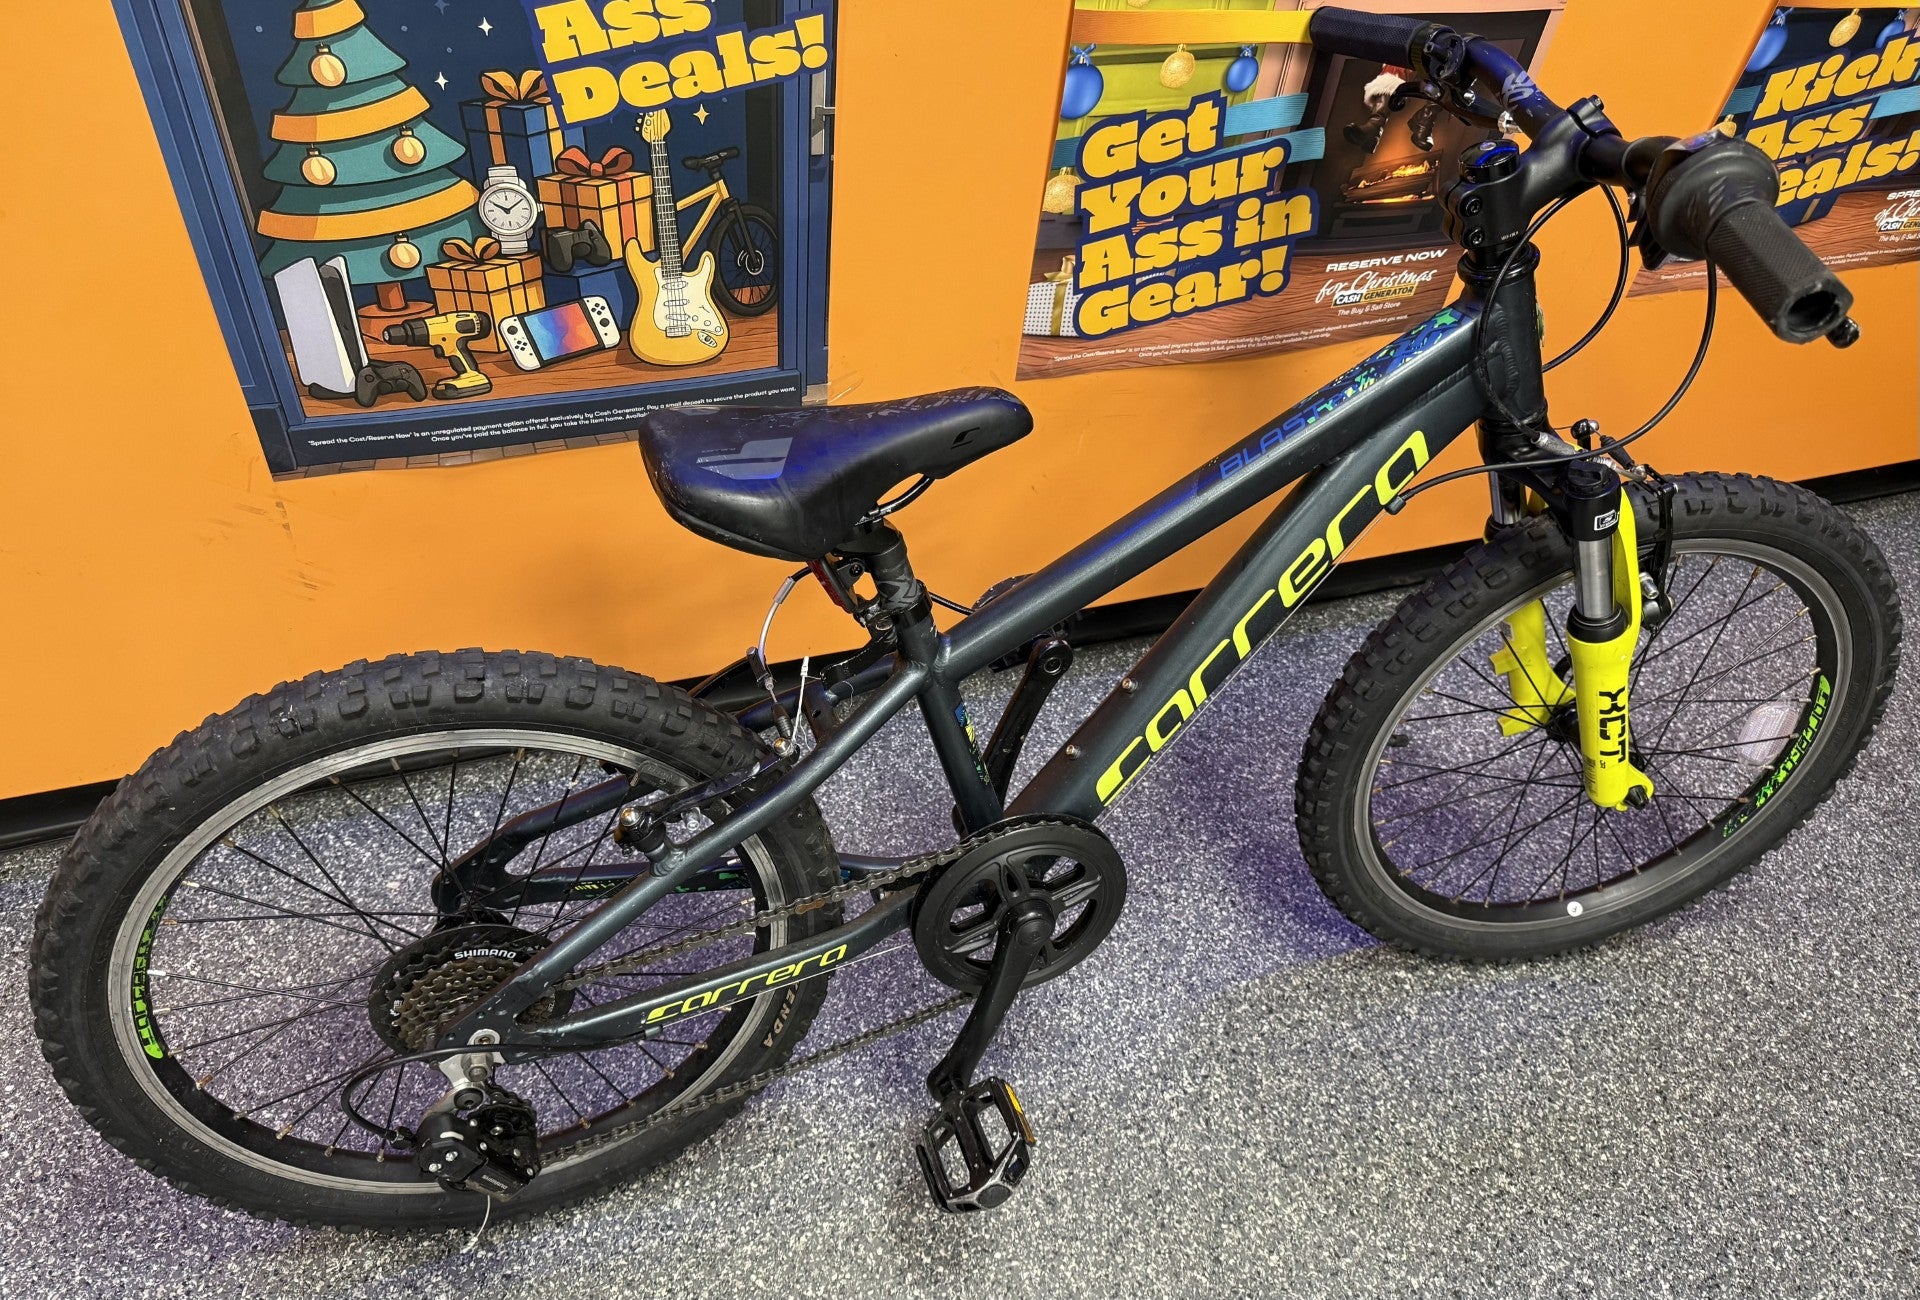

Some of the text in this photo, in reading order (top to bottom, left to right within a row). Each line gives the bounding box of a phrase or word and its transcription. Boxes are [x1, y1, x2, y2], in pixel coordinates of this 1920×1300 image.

[535, 0, 712, 63] Ass
[552, 14, 828, 124] Deals!
[1753, 36, 1920, 120] Kick
[1082, 100, 1219, 178] Get
[1745, 103, 1872, 160] Ass
[1081, 146, 1284, 233] Your
[1775, 129, 1920, 207] eals!
[1079, 194, 1311, 288] Ass in
[1325, 249, 1448, 272] RESERVE NOW
[1078, 245, 1288, 335] Gear!
[1315, 269, 1437, 304] for Christmas
[1336, 286, 1414, 305] CASH GENERATOR
[1350, 306, 1364, 315] Buy
[1383, 302, 1401, 310] Store
[431, 426, 471, 435] unregulated
[473, 423, 501, 431] payment
[683, 399, 704, 407] deposit
[744, 390, 767, 398] product
[451, 433, 472, 441] you've
[1096, 430, 1430, 807] carrera
[1598, 685, 1626, 763] XCT
[454, 948, 517, 961] SHIMANO
[646, 943, 848, 1025] carrera
[763, 983, 799, 1049] ENDA
